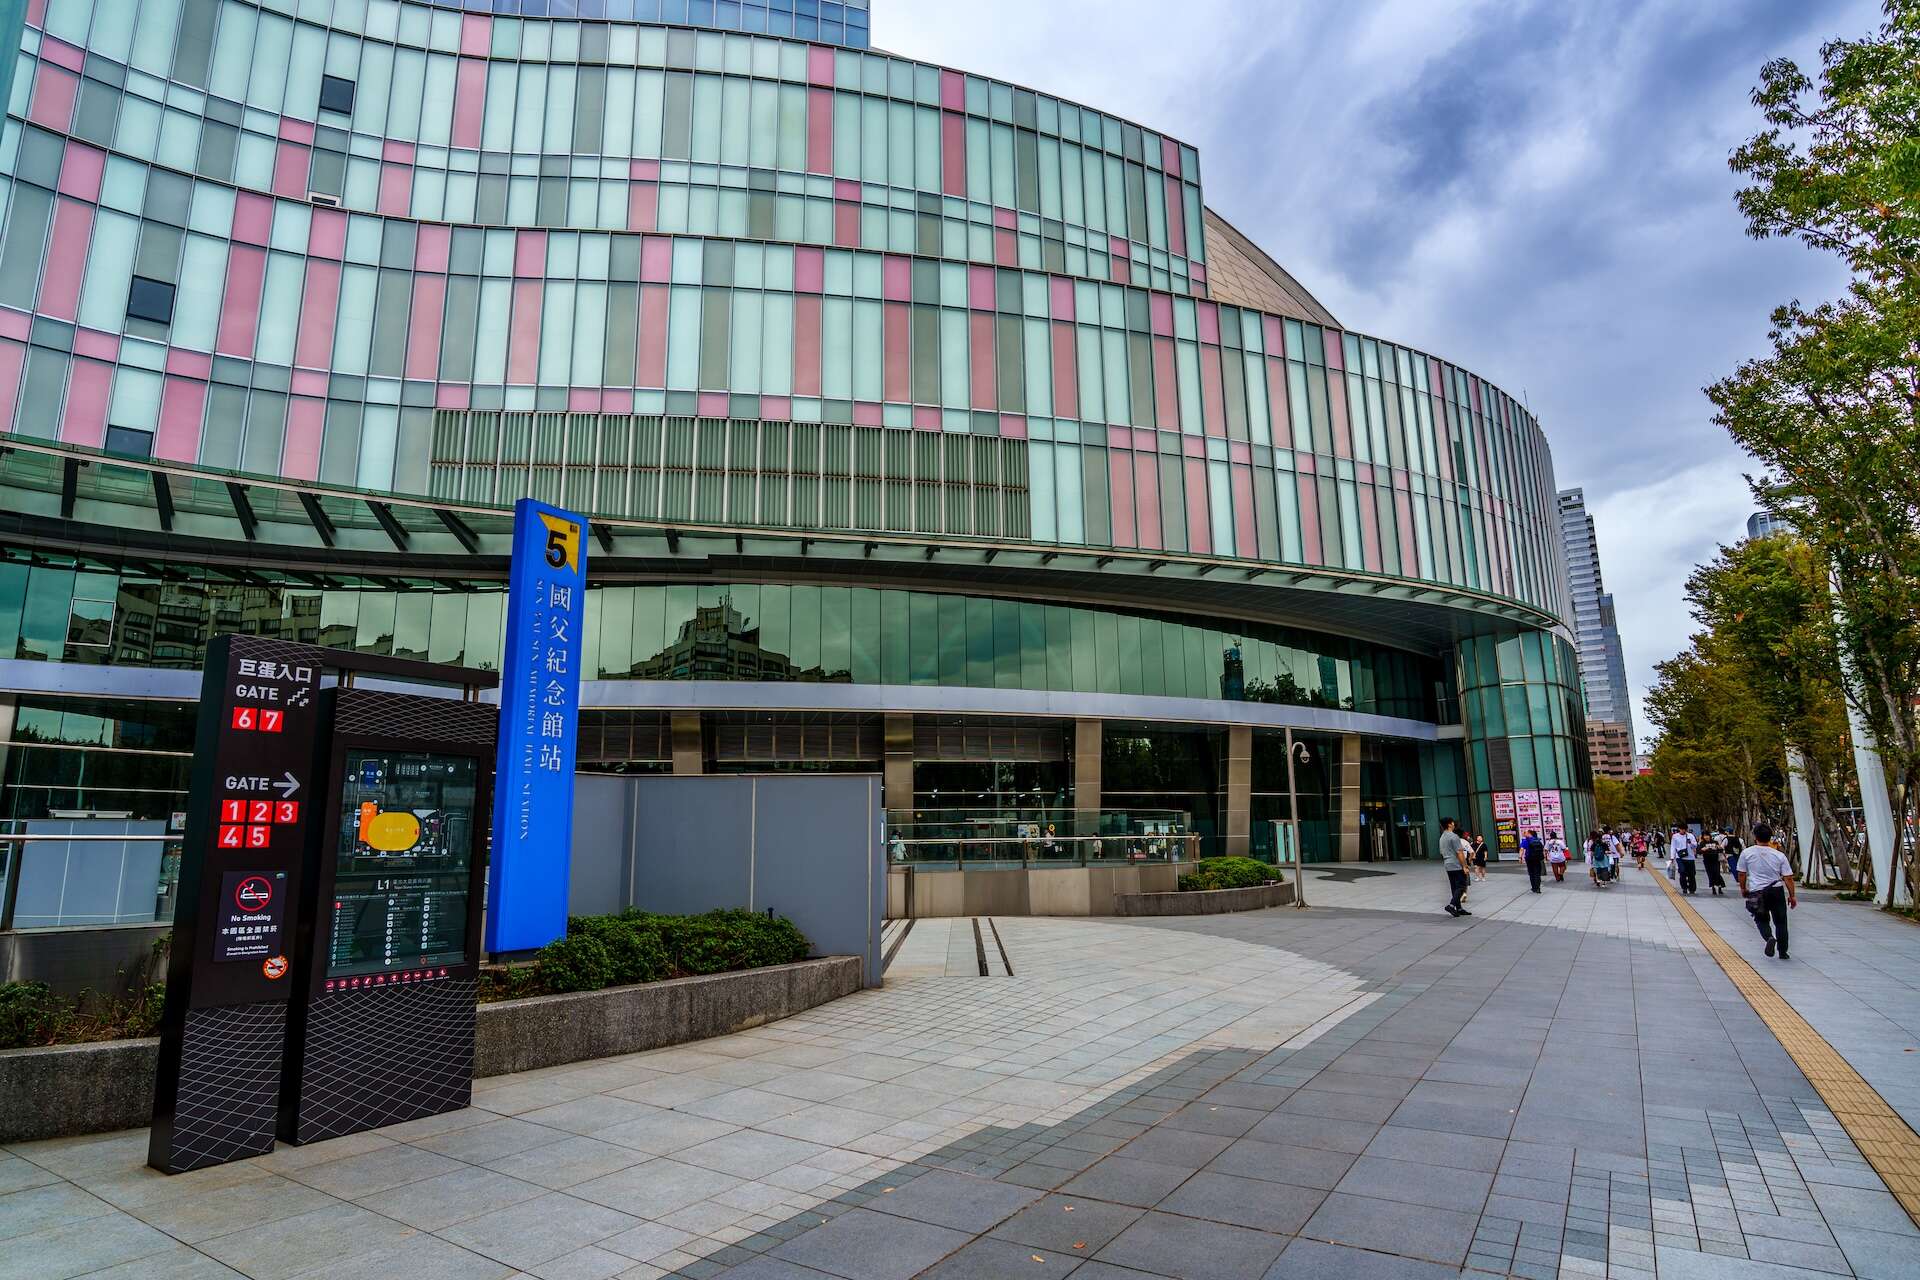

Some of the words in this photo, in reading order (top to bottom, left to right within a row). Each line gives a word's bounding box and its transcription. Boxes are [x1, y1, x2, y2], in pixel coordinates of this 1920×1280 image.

[545, 530, 568, 568] 5
[238, 658, 313, 684] 巨蛋入口
[539, 583, 572, 772] 國父紀念館站
[235, 684, 279, 701] GATE
[238, 709, 252, 728] 6
[265, 711, 279, 730] 7
[225, 776, 270, 791] GATE
[229, 801, 238, 821] 1
[253, 802, 267, 822] 2
[280, 803, 293, 822] 3
[223, 827, 238, 847] 4
[252, 827, 265, 846] 5
[377, 879, 390, 890] L1
[242, 914, 272, 922] Smoking
